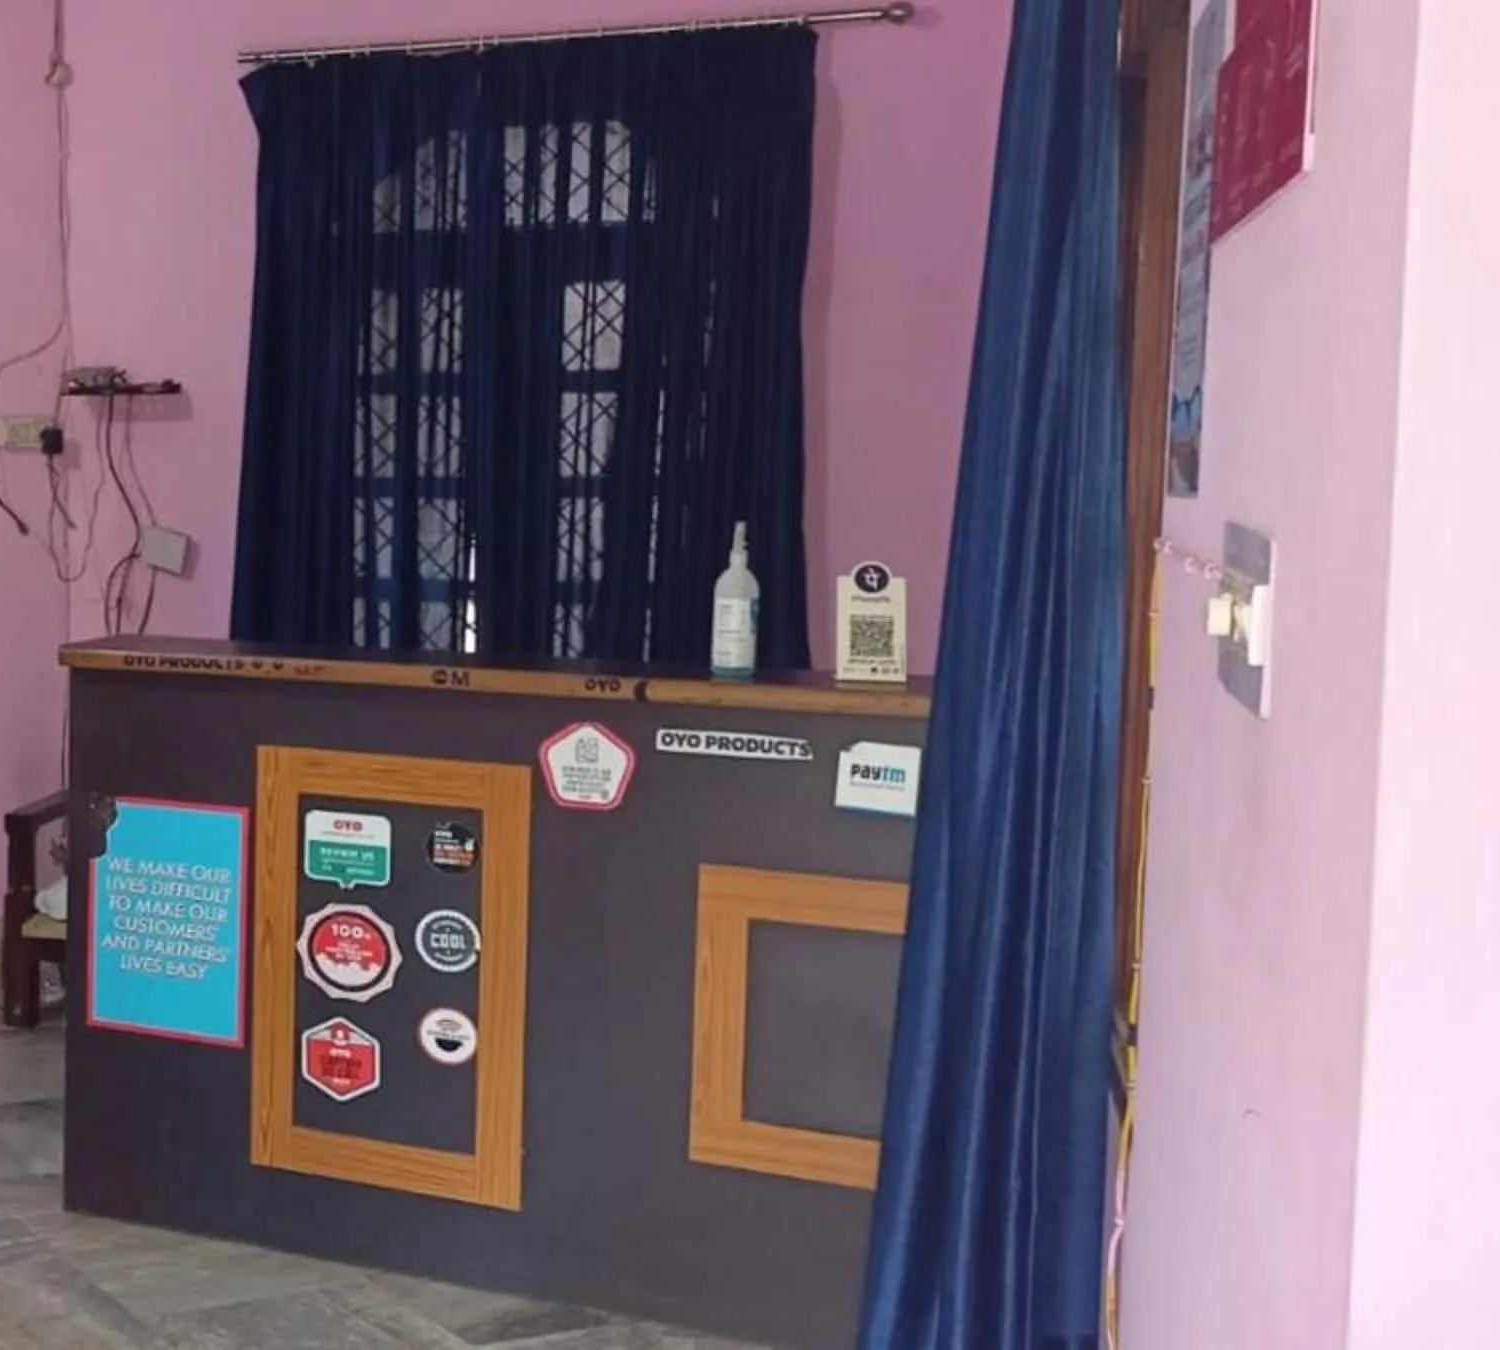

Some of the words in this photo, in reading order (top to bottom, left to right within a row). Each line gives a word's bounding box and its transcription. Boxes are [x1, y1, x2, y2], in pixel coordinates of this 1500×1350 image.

[660, 731, 701, 749] OYO
[705, 735, 810, 758] PRODUCTS
[333, 819, 363, 832] OYO
[107, 857, 134, 874] WE
[137, 860, 187, 879] MAKE
[190, 864, 232, 884] OUR
[105, 875, 148, 894] LIVES
[150, 880, 232, 905] DIFFICULT
[108, 895, 131, 911] TO
[135, 900, 186, 918] MAKE
[189, 904, 229, 923] OUR
[101, 934, 140, 951] AND
[430, 932, 467, 950] COOL
[119, 954, 163, 975] LIVES
[165, 960, 210, 980] EASY
